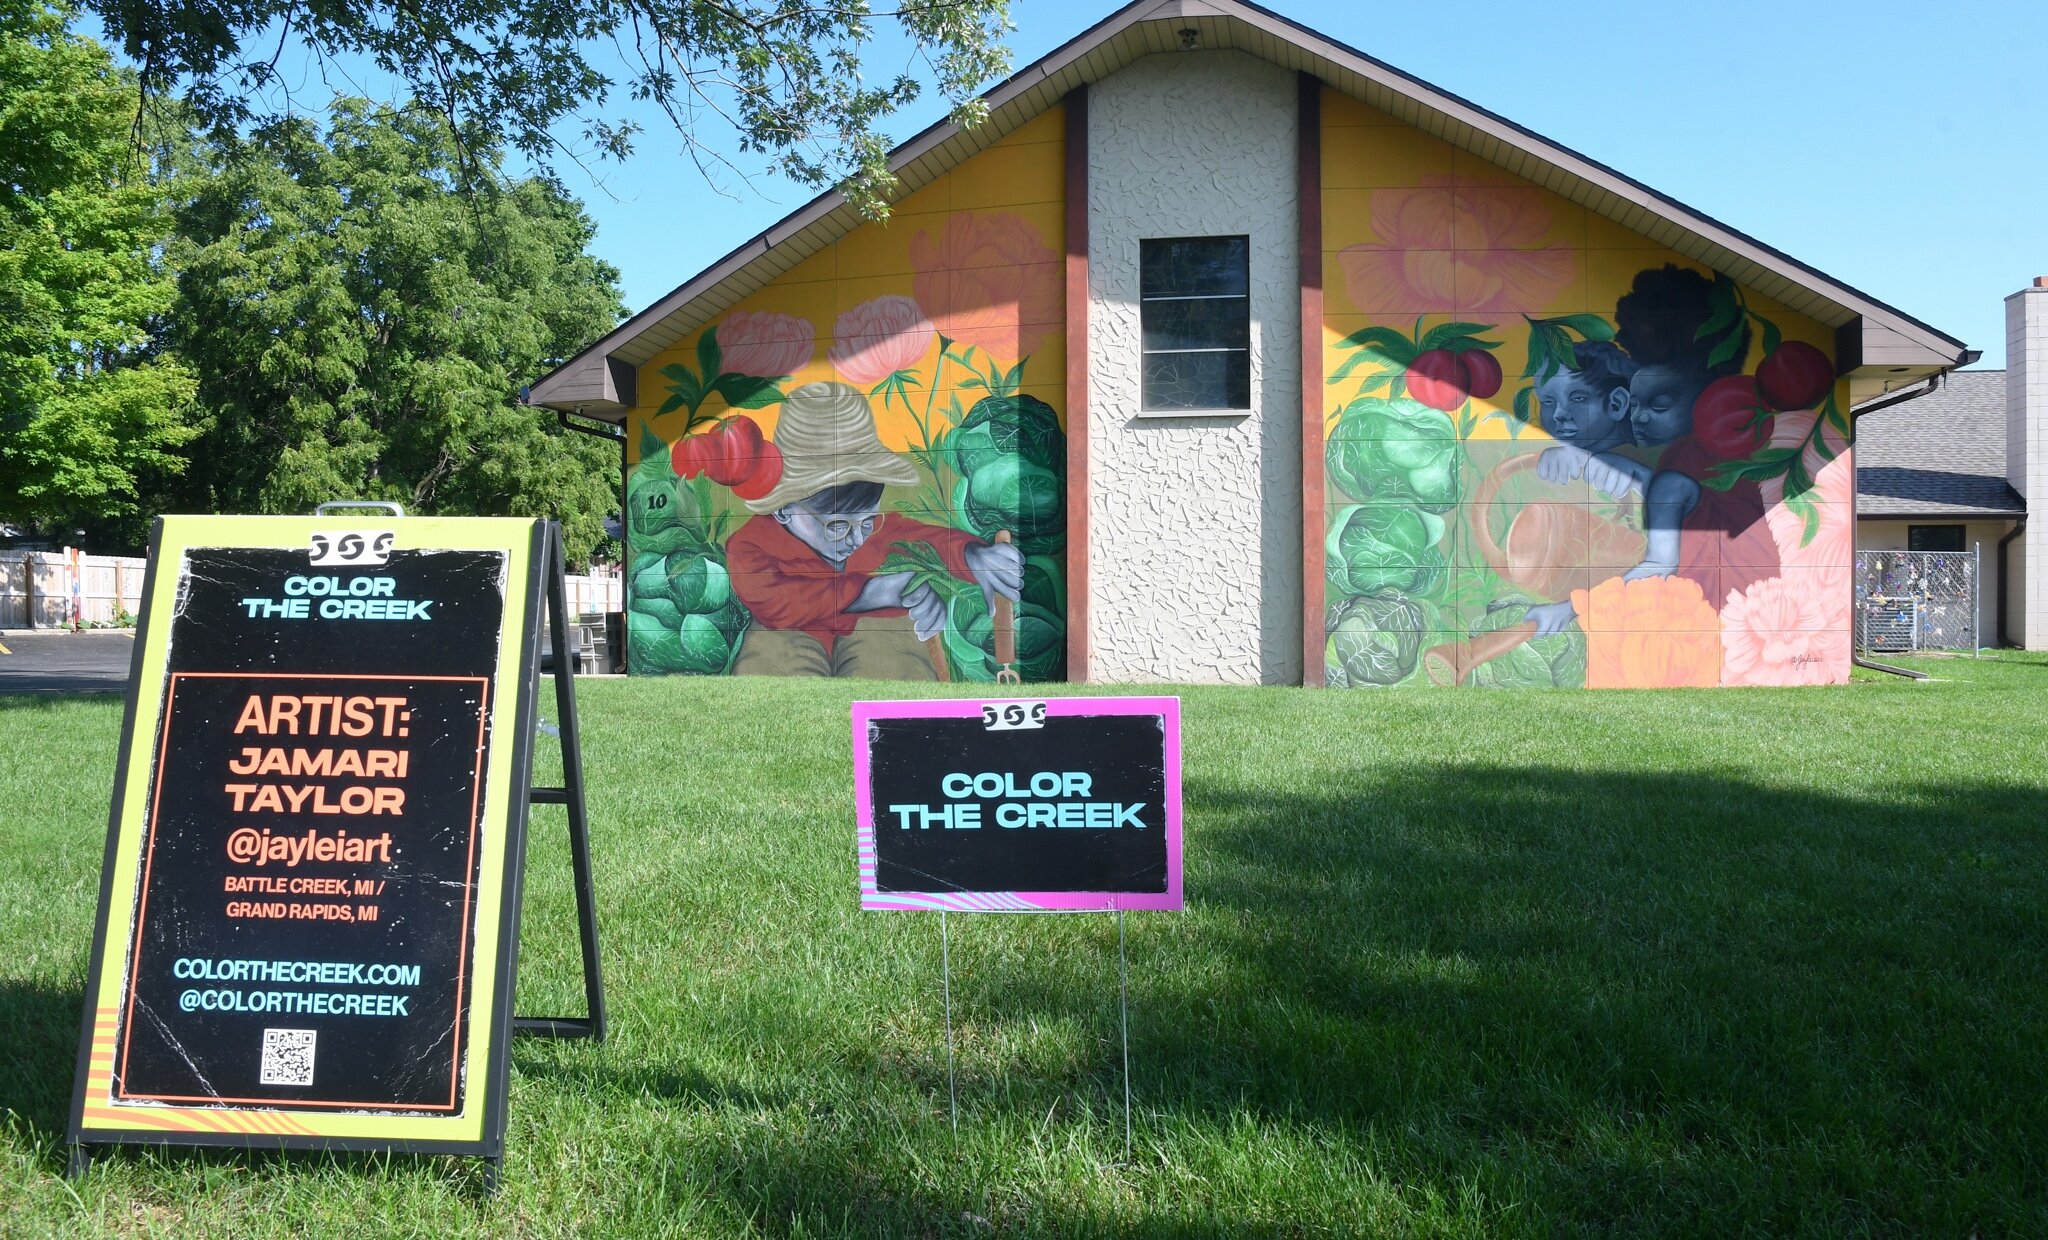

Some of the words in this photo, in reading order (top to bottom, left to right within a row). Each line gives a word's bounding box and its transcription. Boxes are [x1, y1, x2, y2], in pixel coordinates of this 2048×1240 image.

[648, 494, 668, 510] 10
[284, 576, 396, 597] COLOR
[243, 598, 310, 618] THE
[319, 599, 433, 620] CREEK
[234, 695, 410, 737] ARTIST:
[229, 747, 410, 778] JAMARI
[942, 772, 1091, 798] COLOR
[225, 784, 405, 815] TAYLOR
[890, 804, 981, 829] THE
[996, 803, 1147, 828] CREEK
[226, 828, 392, 864] @jayleiart
[224, 877, 287, 894] BATTLE
[289, 878, 351, 896] CREEK,
[355, 879, 374, 895] MI
[226, 902, 286, 919] GRAND
[289, 904, 355, 922] RAPIDS,
[358, 905, 378, 922] MI
[173, 958, 420, 986] COLORTHECREEK.COM
[179, 990, 408, 1016] @COLORTHECREEK
